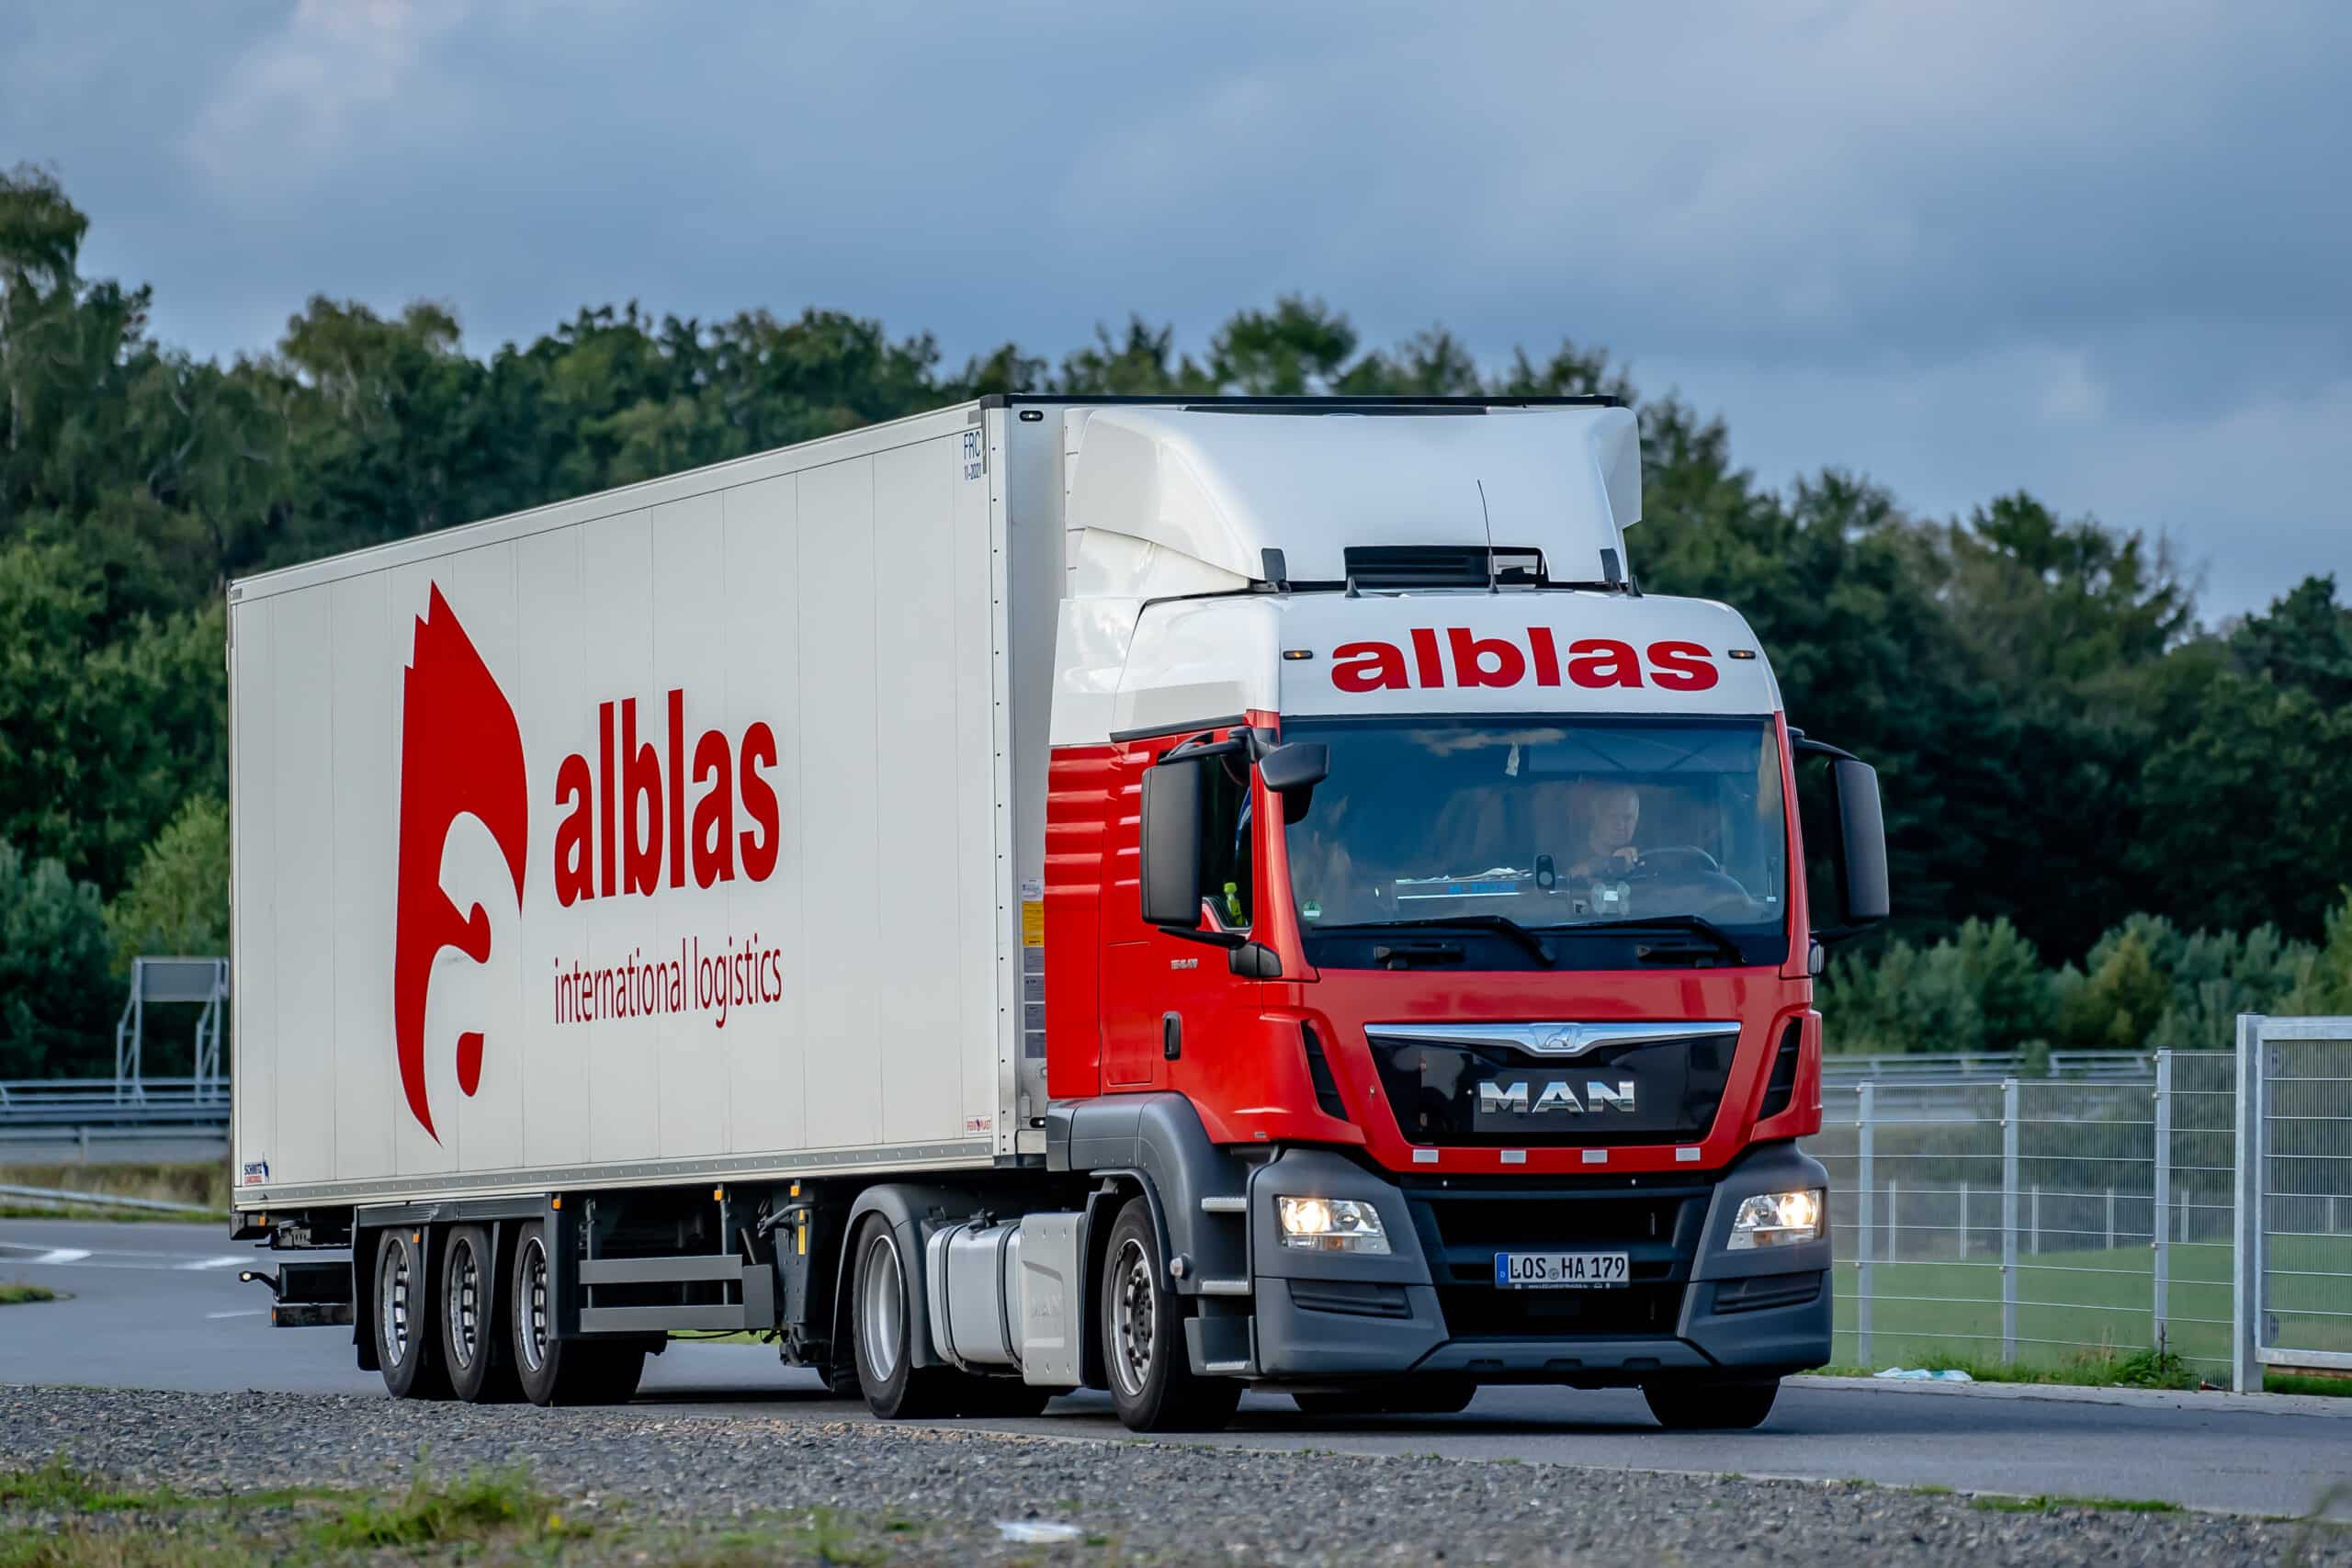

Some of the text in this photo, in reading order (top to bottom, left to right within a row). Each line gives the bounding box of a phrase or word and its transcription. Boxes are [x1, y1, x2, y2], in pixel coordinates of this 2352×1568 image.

[964, 431, 981, 460] FRC
[1331, 626, 1719, 693] alblas
[553, 688, 780, 908] alblas
[555, 931, 782, 1029] international logistics
[1479, 1080, 1635, 1113] MAN
[1510, 1257, 1625, 1280] LOS HA 179
